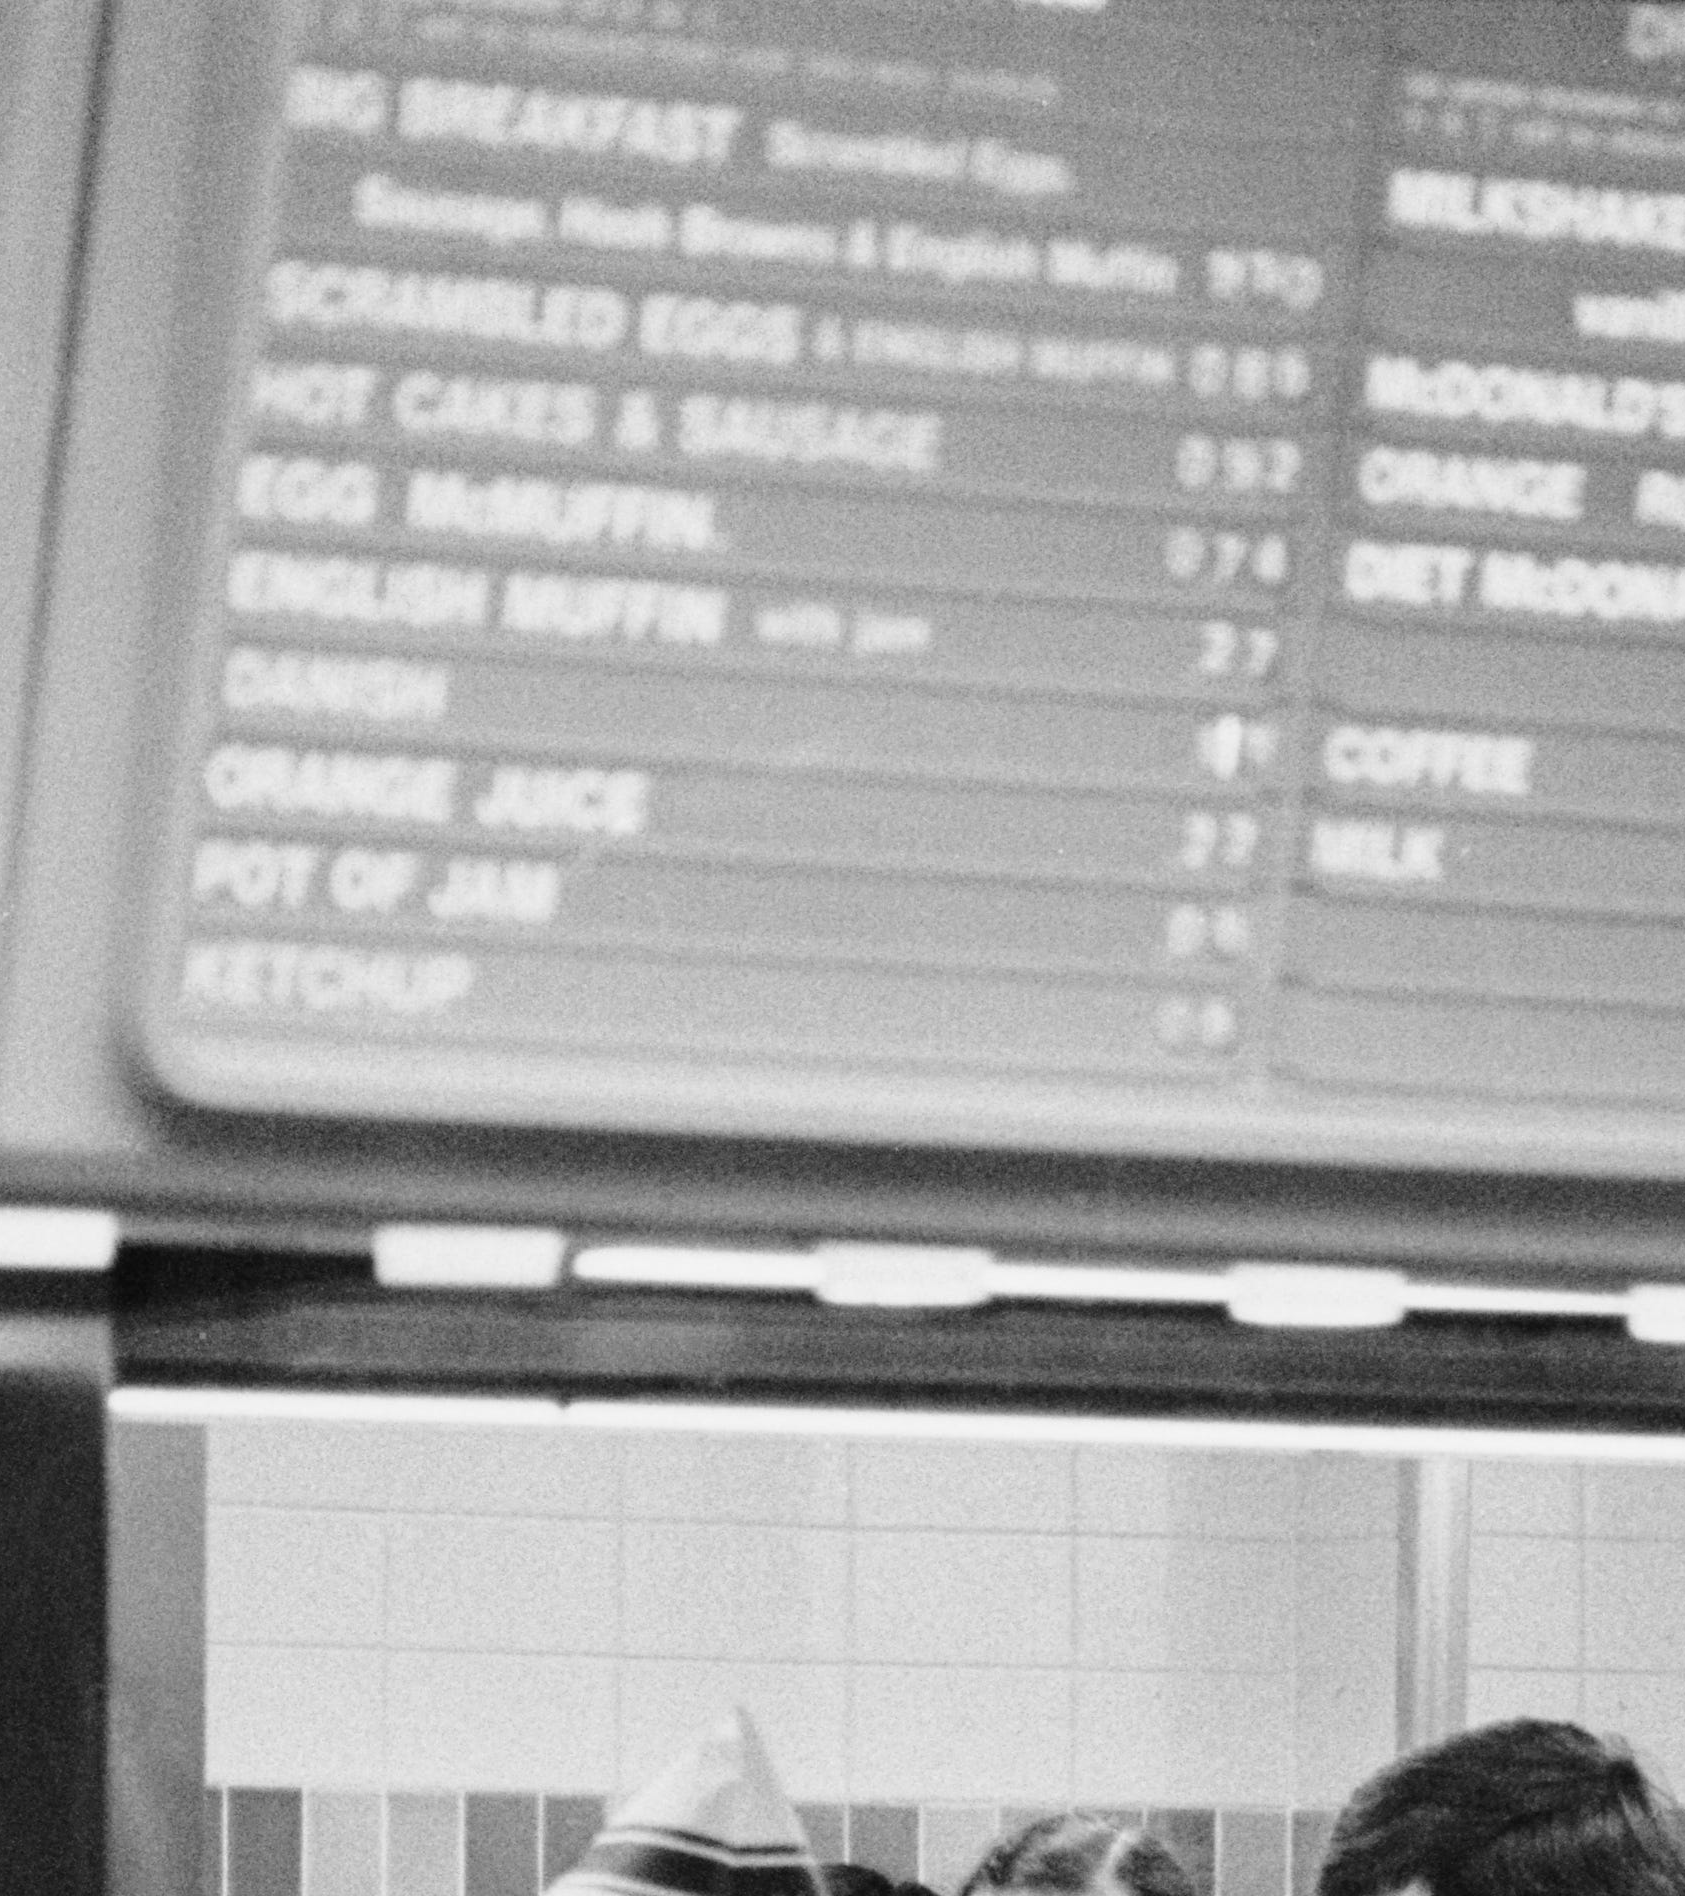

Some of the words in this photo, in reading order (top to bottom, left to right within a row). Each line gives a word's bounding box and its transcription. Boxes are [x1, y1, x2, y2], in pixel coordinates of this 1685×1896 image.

[284, 66, 387, 132] BIG
[398, 76, 744, 163] BREAKFAST
[266, 259, 629, 350] SCRAMBLED
[639, 292, 804, 364] EGGS
[252, 357, 378, 427] HOT
[393, 371, 598, 445] CAKES
[679, 394, 944, 472] SAUSAGE
[236, 454, 380, 525] EGG
[1358, 445, 1588, 518] ORANGE
[226, 549, 492, 627] ENGLISH
[502, 569, 727, 647] MUFFIN
[1344, 539, 1474, 603] DIET
[221, 647, 449, 721] DANISH
[203, 744, 461, 823] ORANGE
[475, 766, 651, 835] JUICE
[1323, 725, 1535, 798] COFFEE
[190, 837, 315, 908] POT
[329, 847, 422, 913] OF
[427, 857, 563, 921] JAM
[1311, 819, 1446, 880] MILK
[181, 942, 477, 1013] KETCHUP
